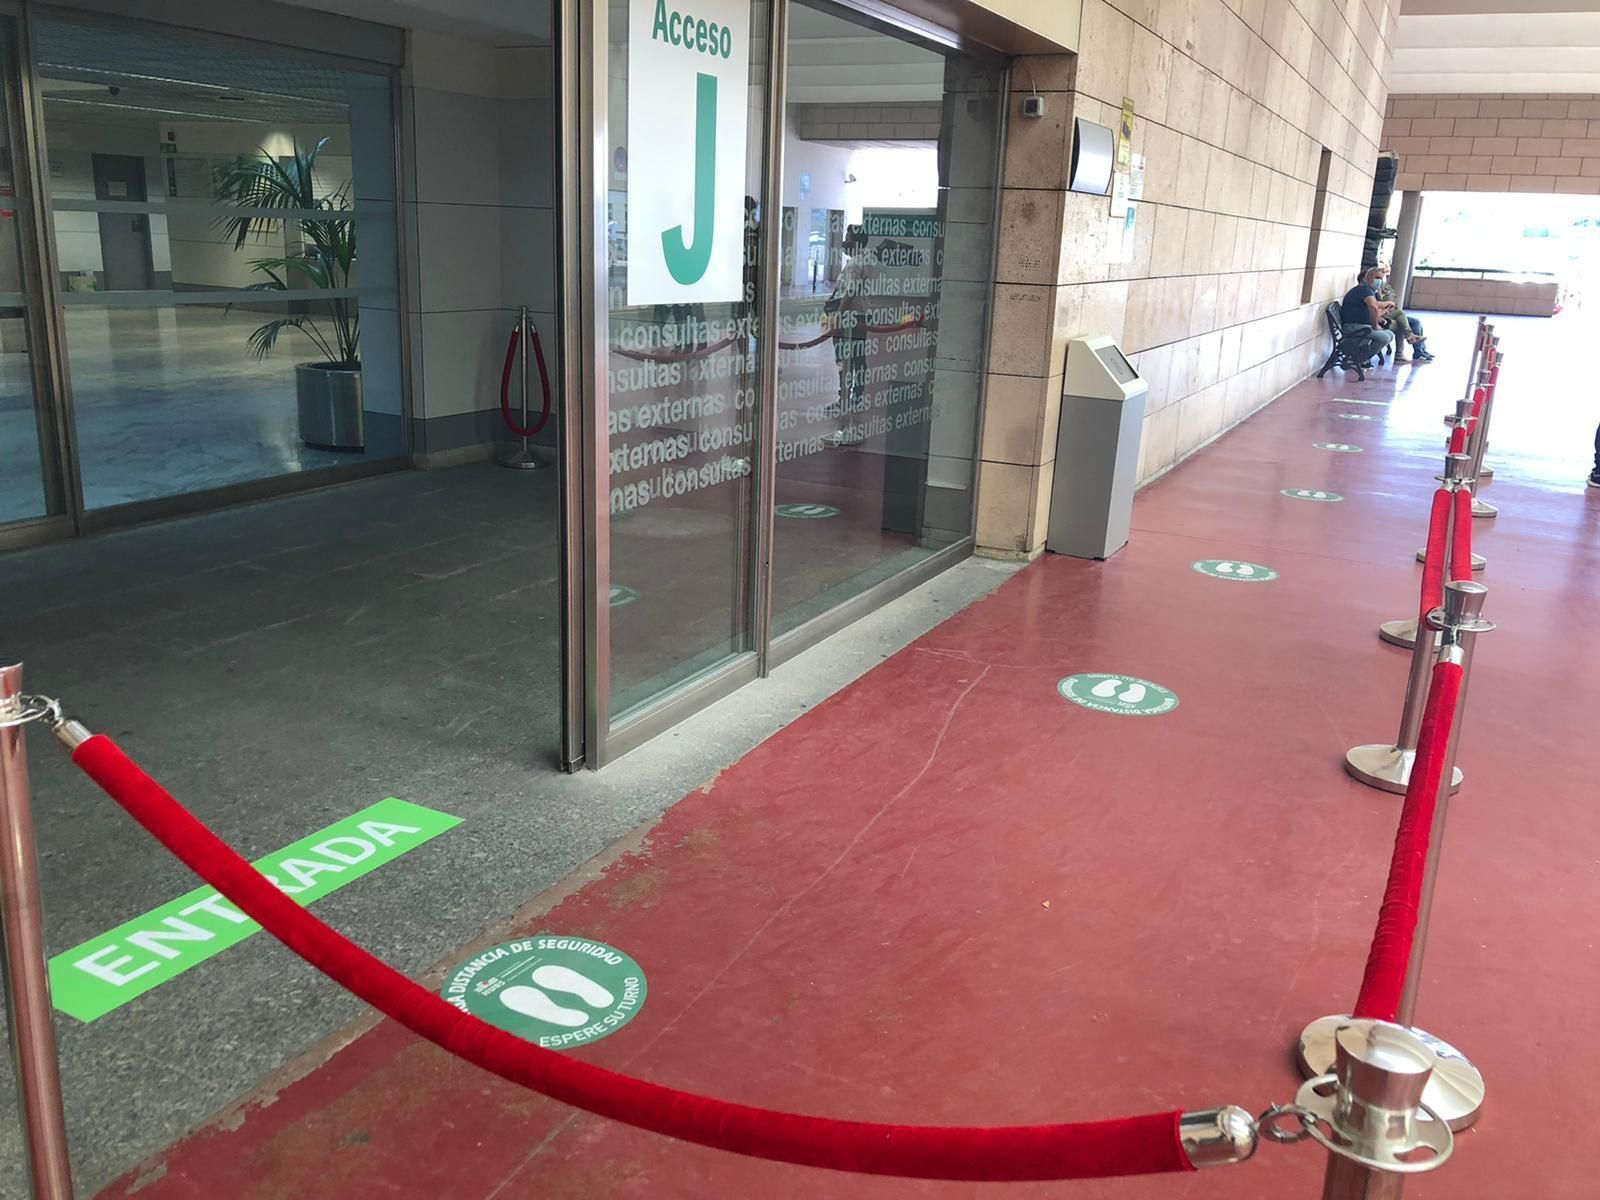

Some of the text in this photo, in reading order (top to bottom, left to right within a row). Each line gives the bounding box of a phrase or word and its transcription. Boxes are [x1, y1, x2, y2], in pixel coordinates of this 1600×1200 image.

[652, 0, 731, 59] Acceso
[661, 72, 718, 285] J
[881, 243, 931, 267] externas
[837, 272, 900, 298] consultas
[865, 300, 921, 326] consultas
[620, 315, 720, 350] consultas
[885, 327, 938, 353] consultas
[844, 363, 898, 389] externas
[637, 392, 724, 429] externas
[735, 388, 755, 410] co
[806, 391, 871, 424] consultas
[874, 382, 923, 407] externas
[833, 415, 892, 447] consultas
[662, 455, 752, 498] consultas
[448, 948, 509, 995] DISTANCIA
[510, 940, 533, 954] DE
[538, 939, 623, 965] SEGURIDAD
[539, 976, 639, 1048] ESPERE SU TURNO
